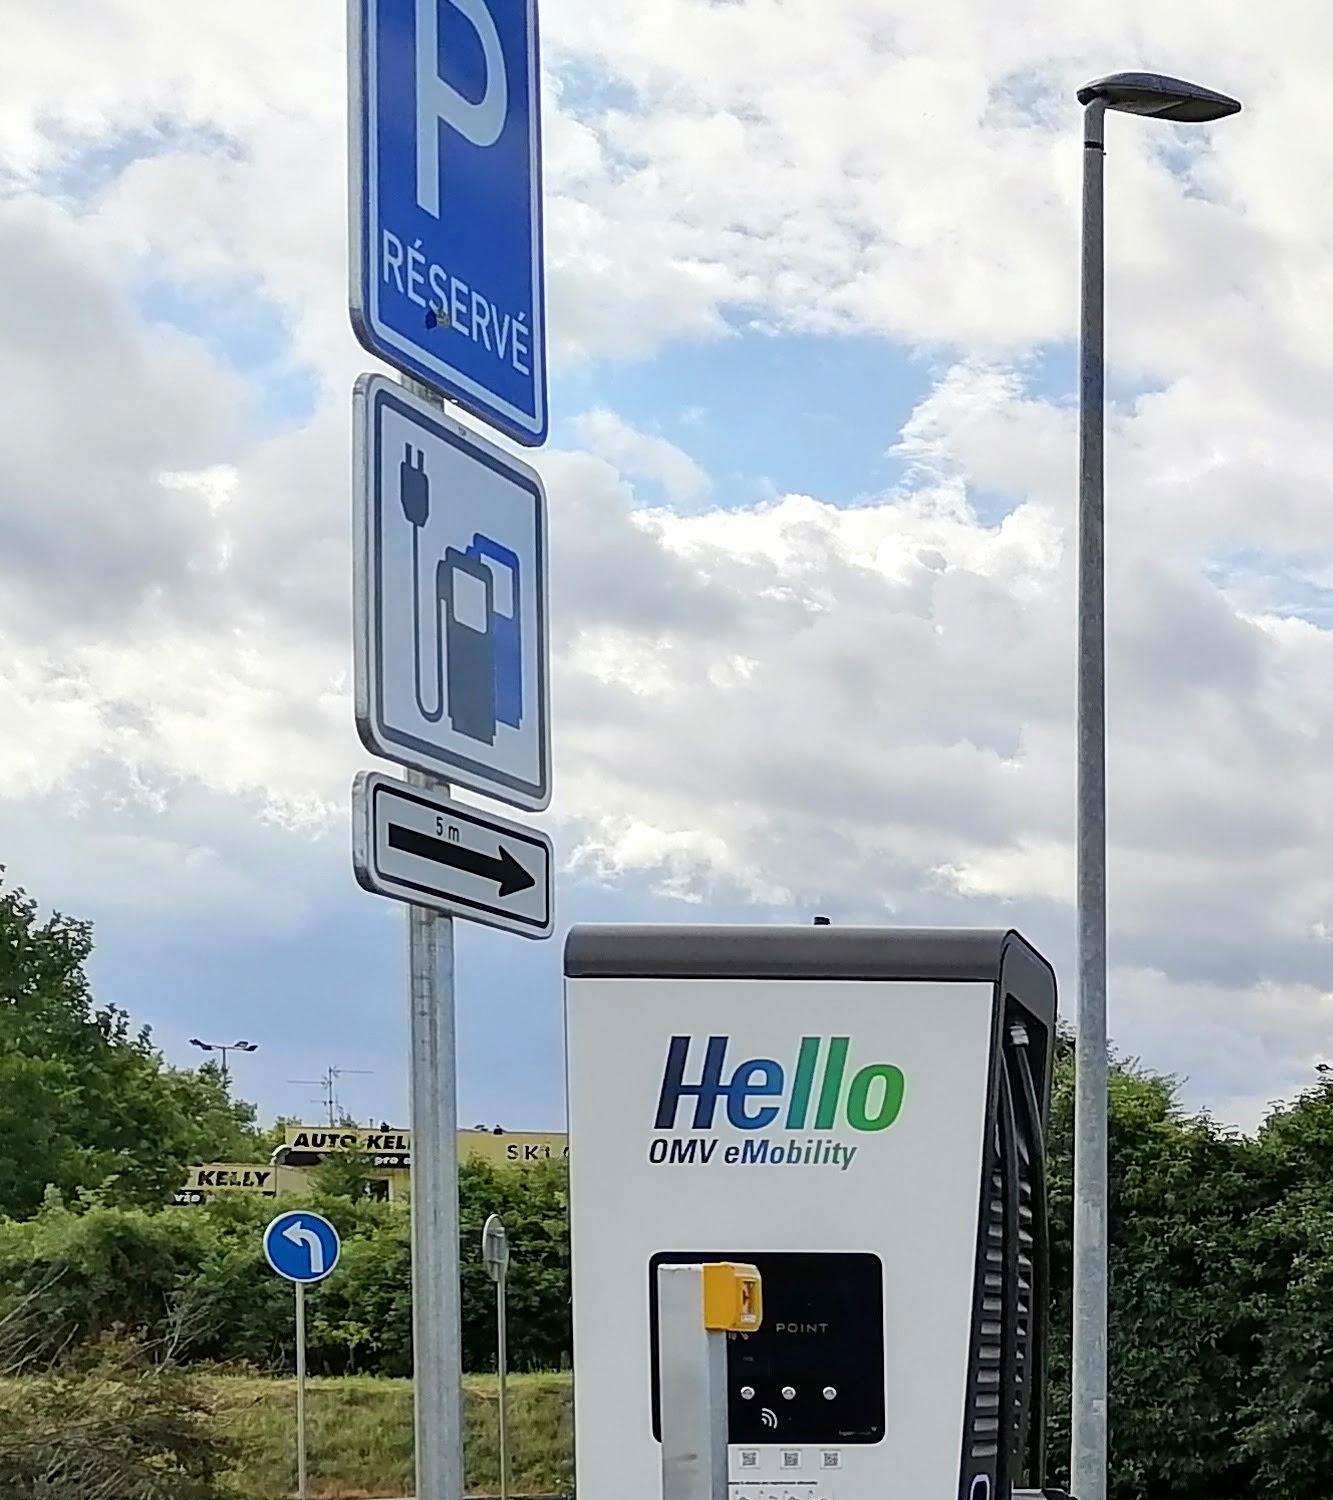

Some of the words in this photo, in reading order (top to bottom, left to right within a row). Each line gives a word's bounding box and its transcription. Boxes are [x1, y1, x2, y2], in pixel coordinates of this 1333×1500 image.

[415, 0, 508, 219] P
[382, 228, 530, 376] RÉSERVÉ
[436, 816, 443, 836] 5
[448, 825, 460, 842] m
[653, 1035, 905, 1131] Hello
[293, 1132, 357, 1149] AUTO
[367, 1134, 411, 1150] KEL
[649, 1138, 719, 1164] OMV
[724, 1138, 858, 1171] eMobility
[197, 1170, 271, 1187] KELLY
[775, 1322, 829, 1334] POINT
